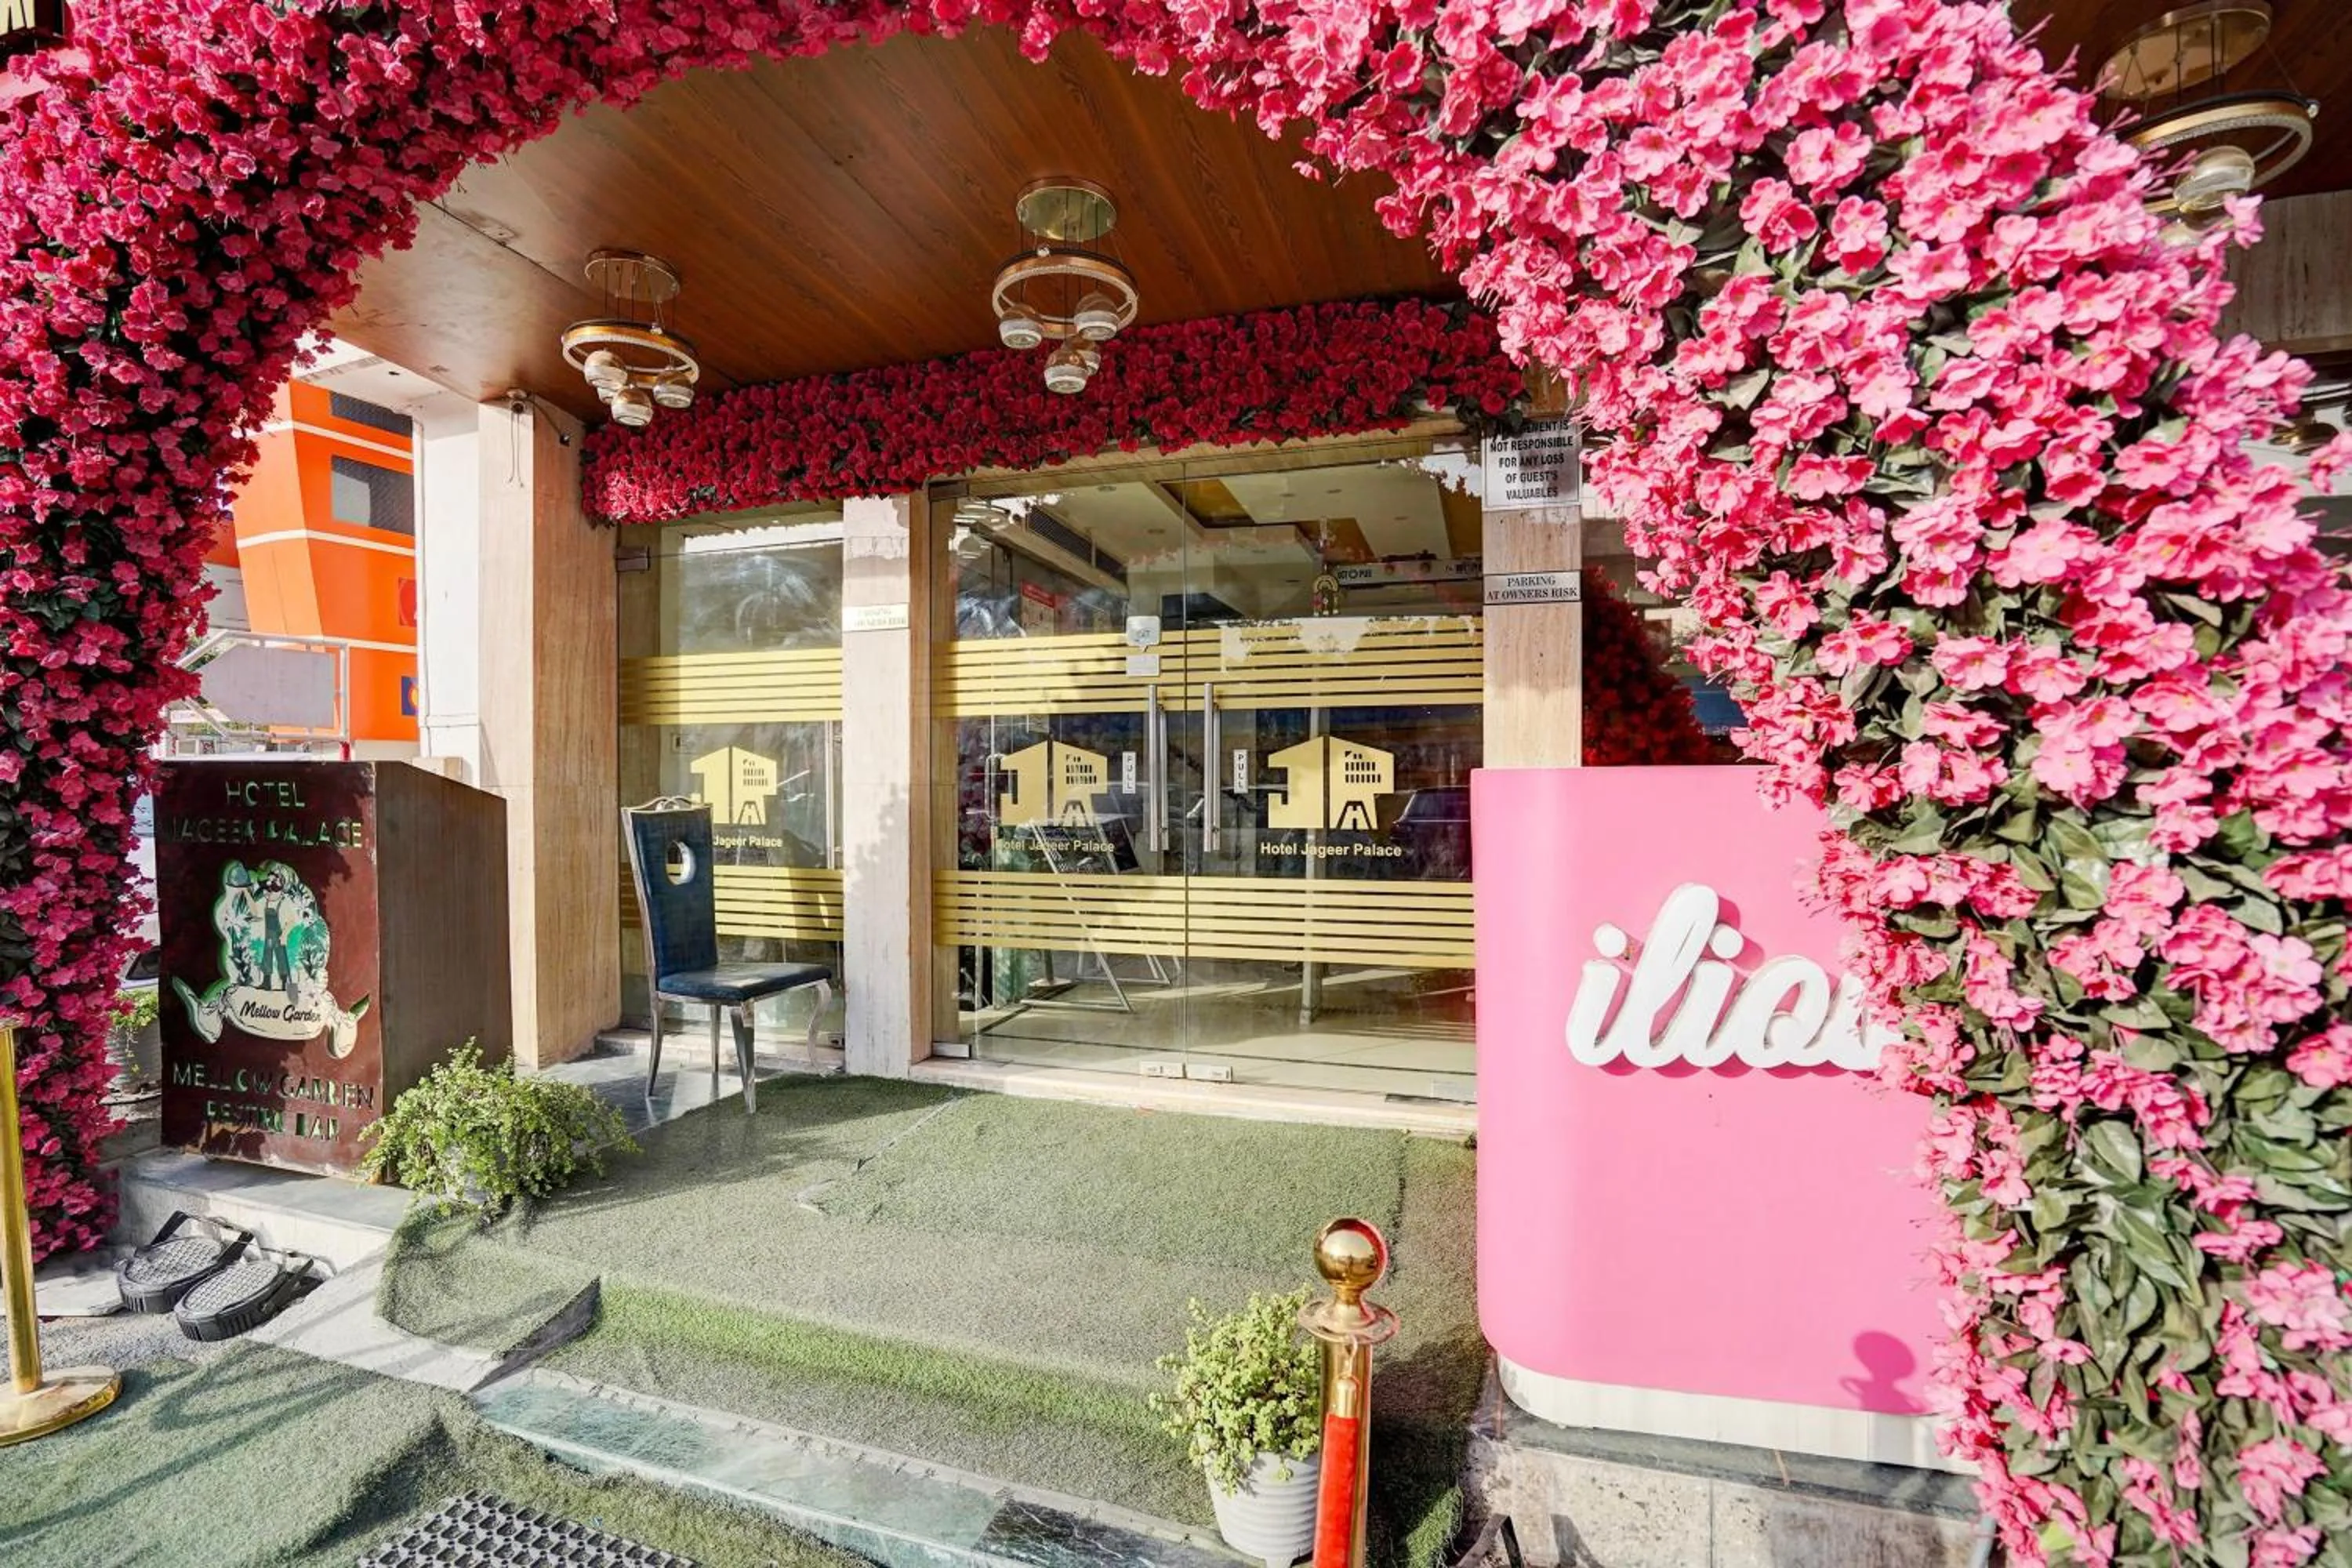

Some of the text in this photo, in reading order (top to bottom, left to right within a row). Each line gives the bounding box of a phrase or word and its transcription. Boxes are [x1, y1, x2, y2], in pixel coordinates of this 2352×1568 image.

[1490, 436, 1573, 452] NOT RESPONSIBLE
[1499, 452, 1564, 468] FOR ANY LOSS
[1505, 470, 1558, 484] OF GUEST'S
[1505, 487, 1559, 499] VALUABLES
[1507, 575, 1555, 587] PARKING
[1486, 586, 1578, 601] AT OWNERS RISK
[1125, 754, 1134, 790] PULL
[1237, 753, 1246, 789] PULL
[225, 781, 307, 808] HOTEL
[749, 835, 784, 848] Palace
[1073, 840, 1115, 852] Palace
[1260, 841, 1403, 859] Hotel Jageer Palace
[239, 1000, 321, 1022] Mellow Garden
[278, 1073, 375, 1112] GARDEN
